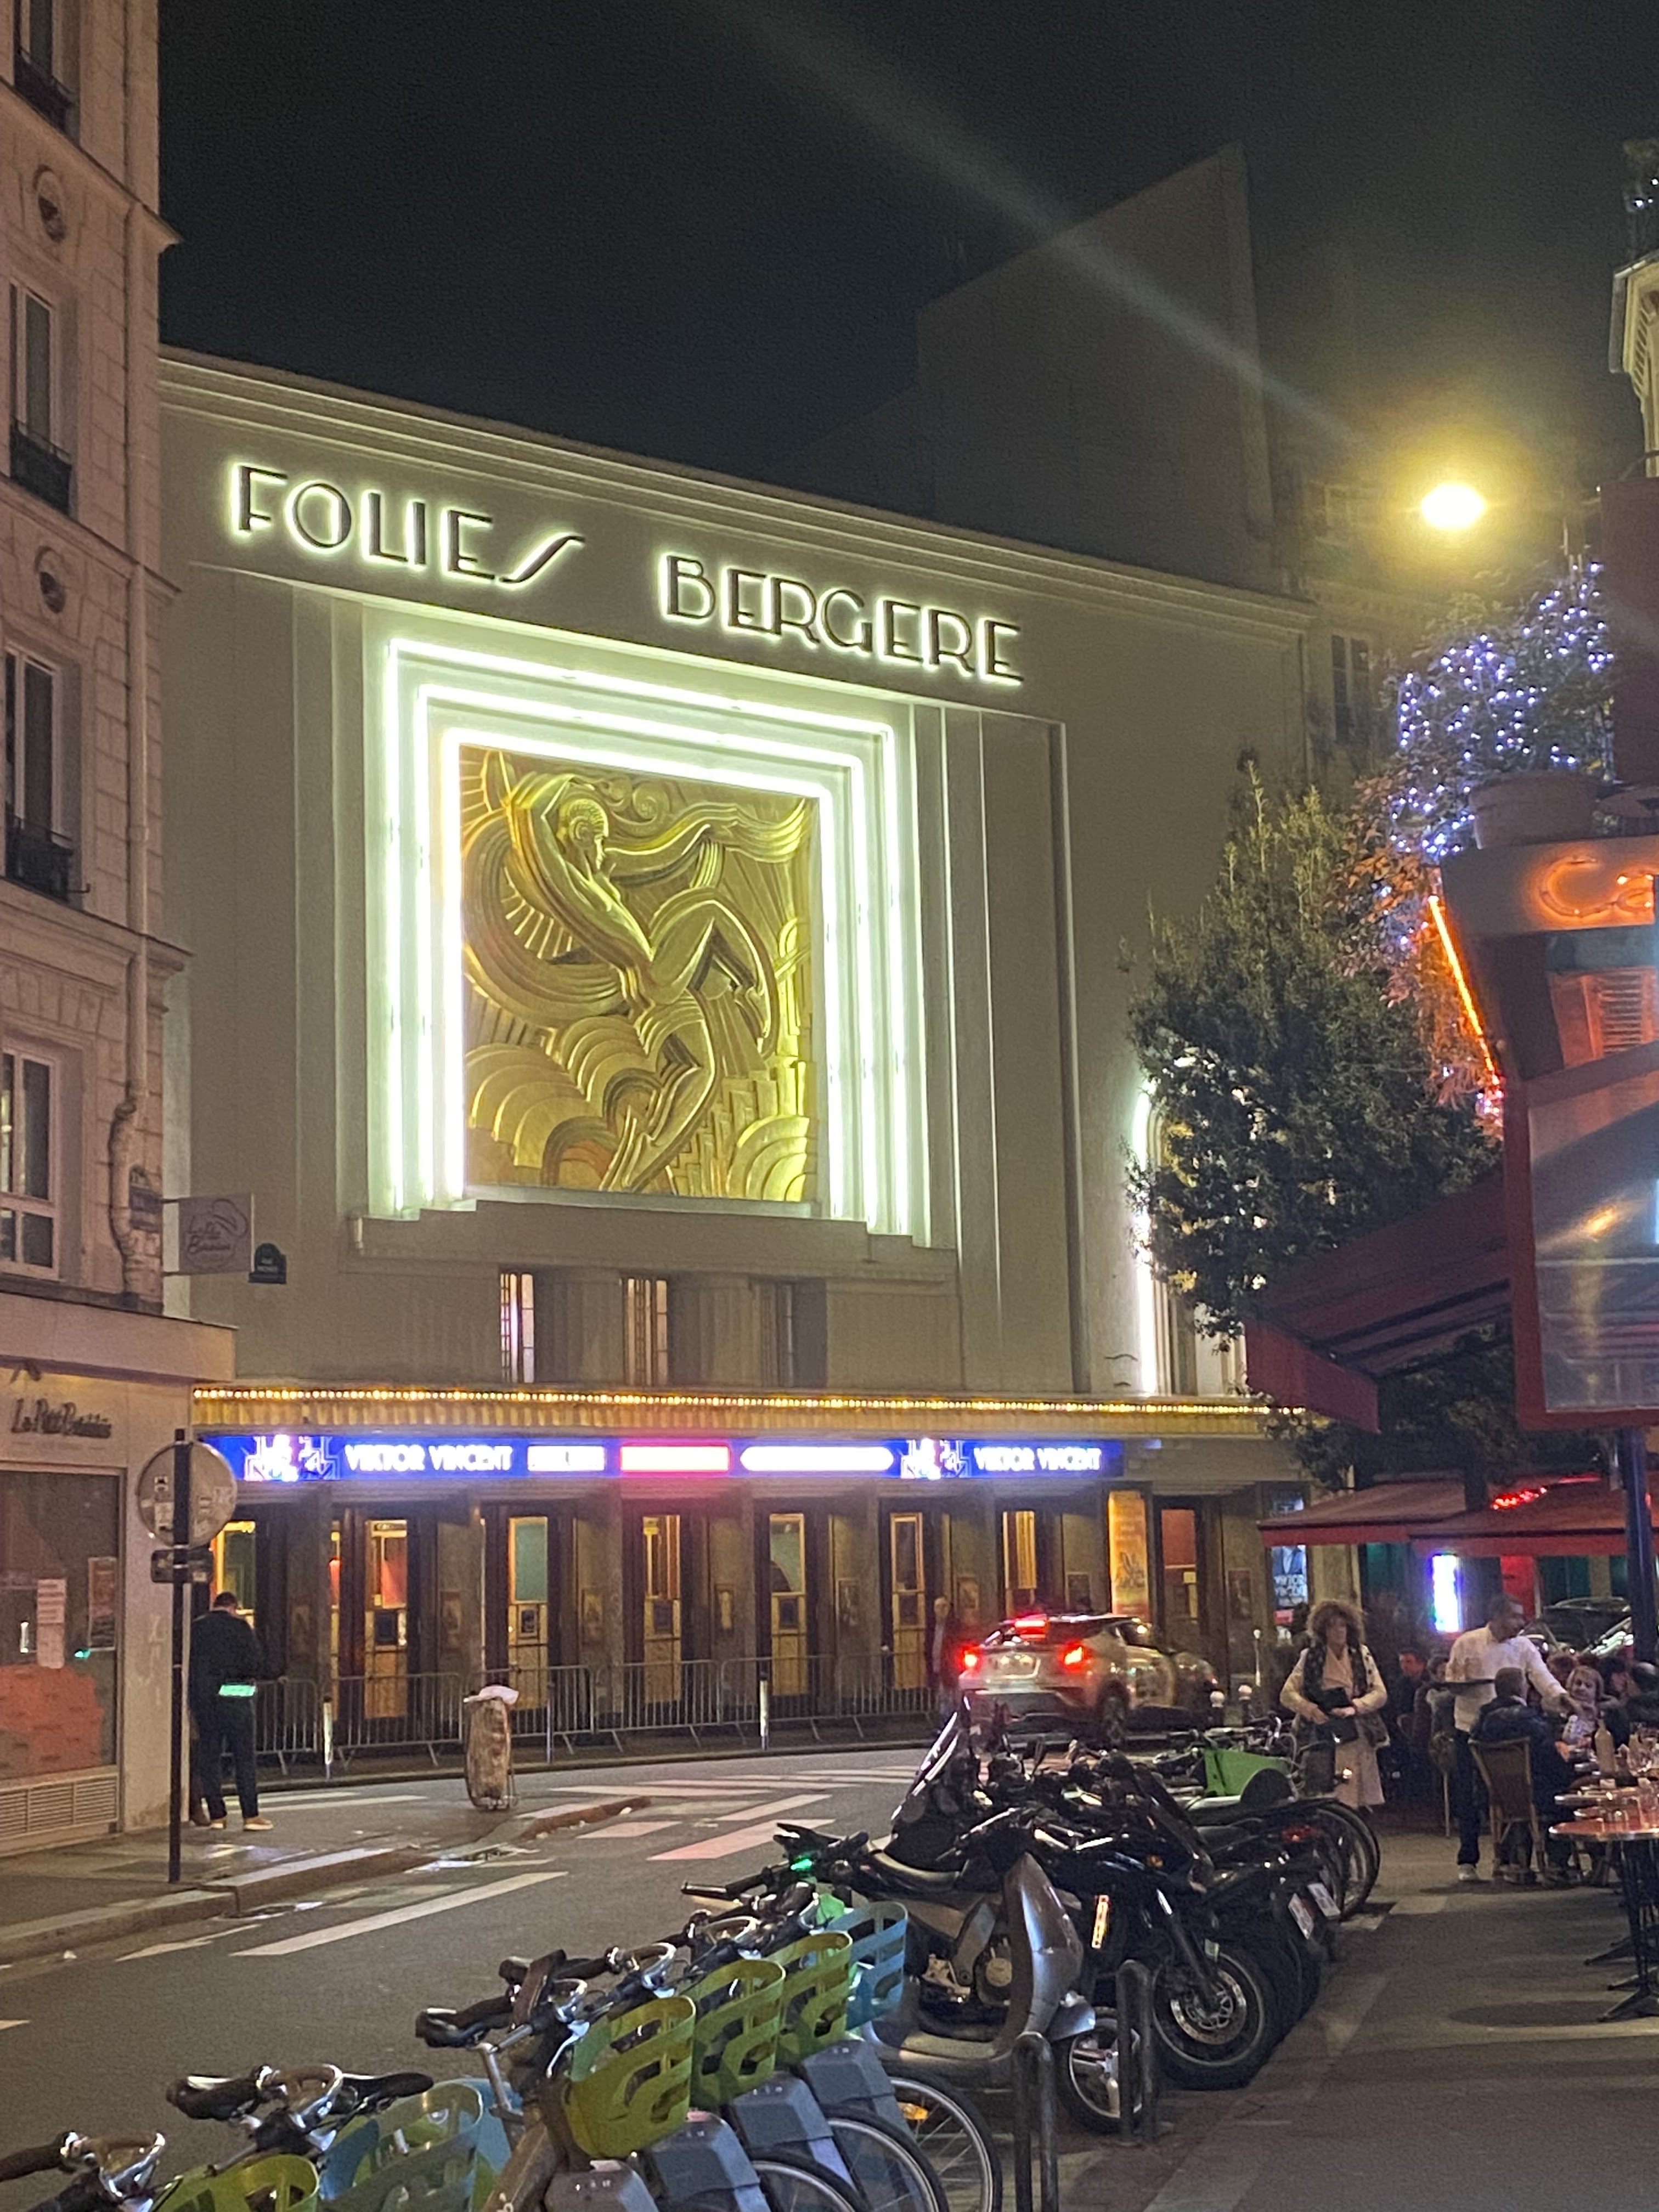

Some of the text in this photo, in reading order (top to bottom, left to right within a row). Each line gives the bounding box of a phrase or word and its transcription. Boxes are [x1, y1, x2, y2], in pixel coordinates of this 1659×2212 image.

[232, 462, 1024, 686] FOLIES BERGERE
[345, 1444, 425, 1471] VIKTOR
[428, 1445, 512, 1471] VINCENT
